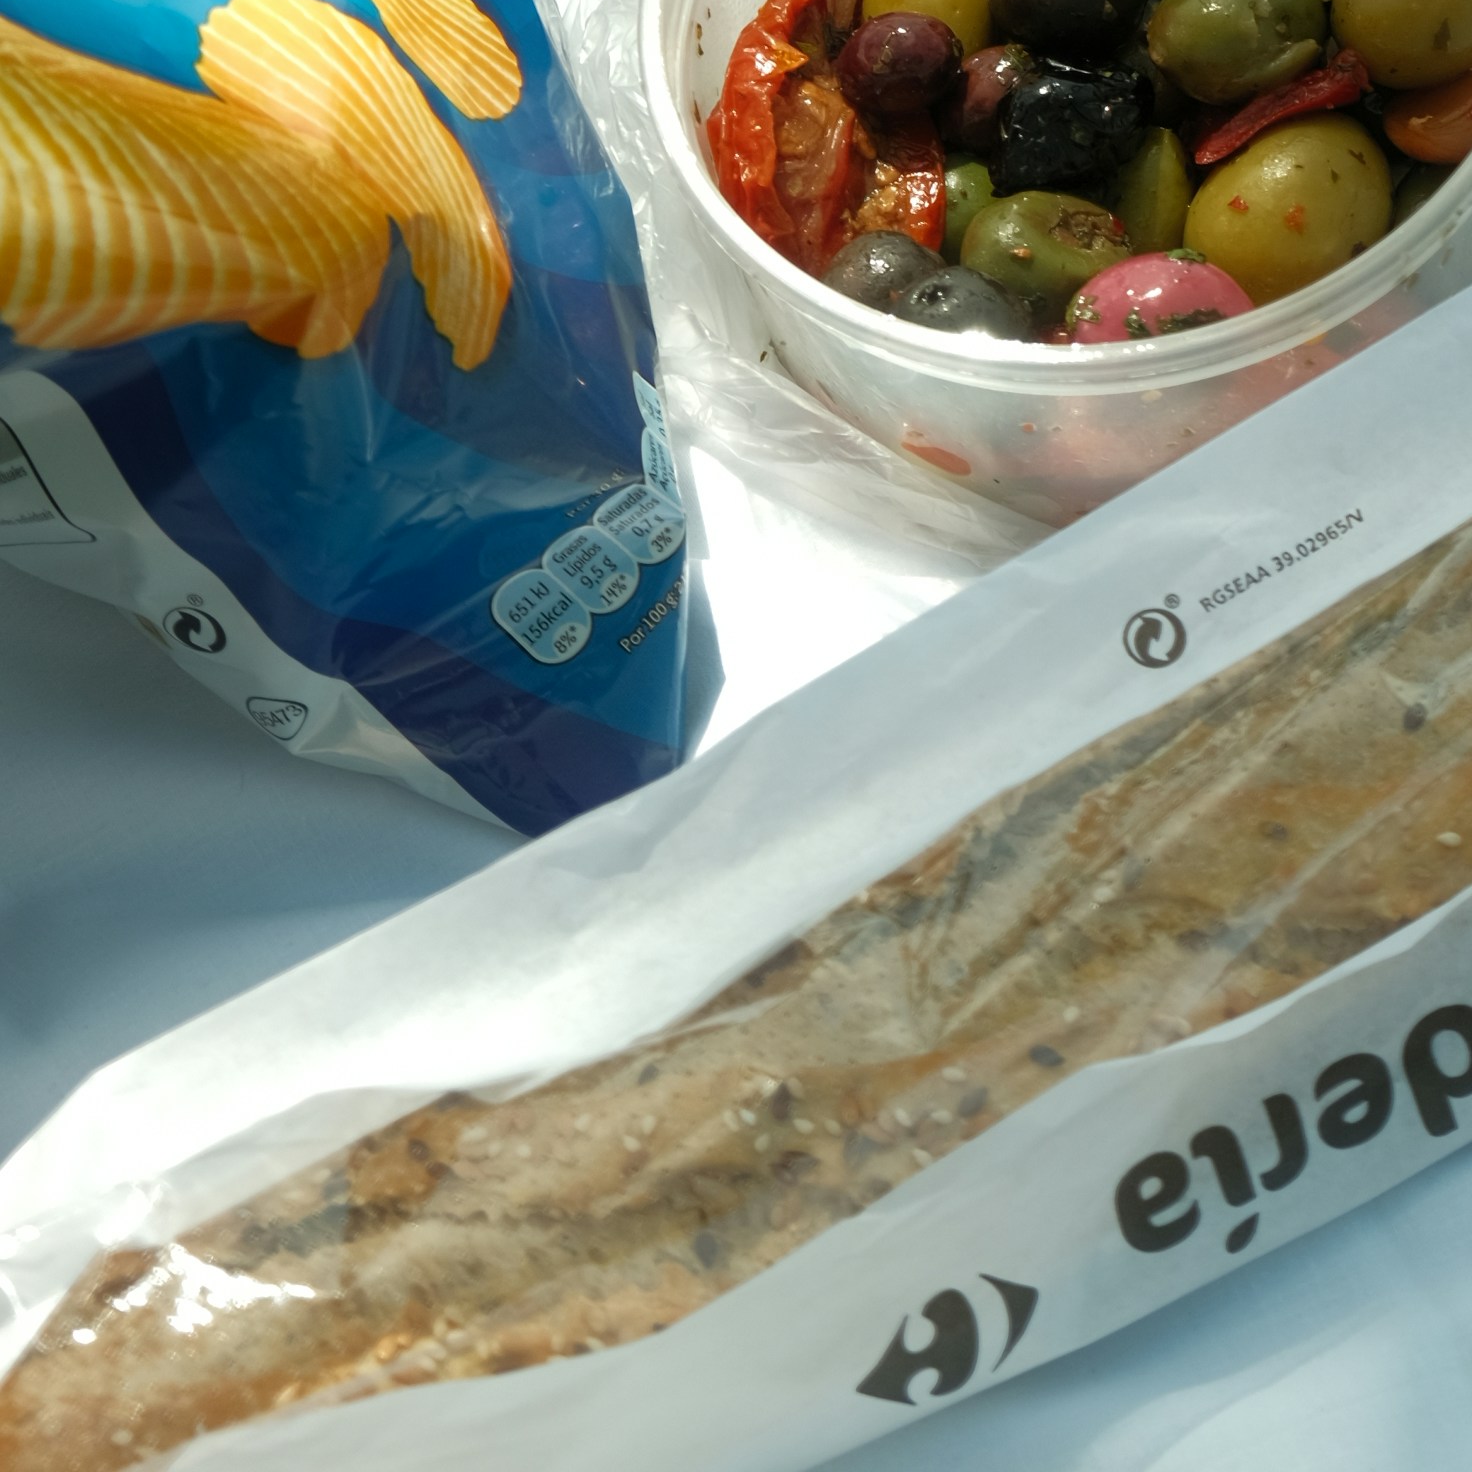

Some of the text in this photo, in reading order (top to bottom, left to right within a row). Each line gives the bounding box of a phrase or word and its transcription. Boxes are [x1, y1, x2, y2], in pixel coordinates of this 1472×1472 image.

[596, 485, 648, 529] Saturadas
[608, 495, 661, 537] Saturados
[550, 532, 588, 565] Grasas
[561, 540, 602, 578] Lípidos
[578, 553, 620, 591] 9,5 g
[1198, 562, 1271, 614] RGSEAA
[505, 579, 552, 625] 651 kJ
[521, 591, 574, 646] 156kcal
[616, 599, 670, 653] Por 100
